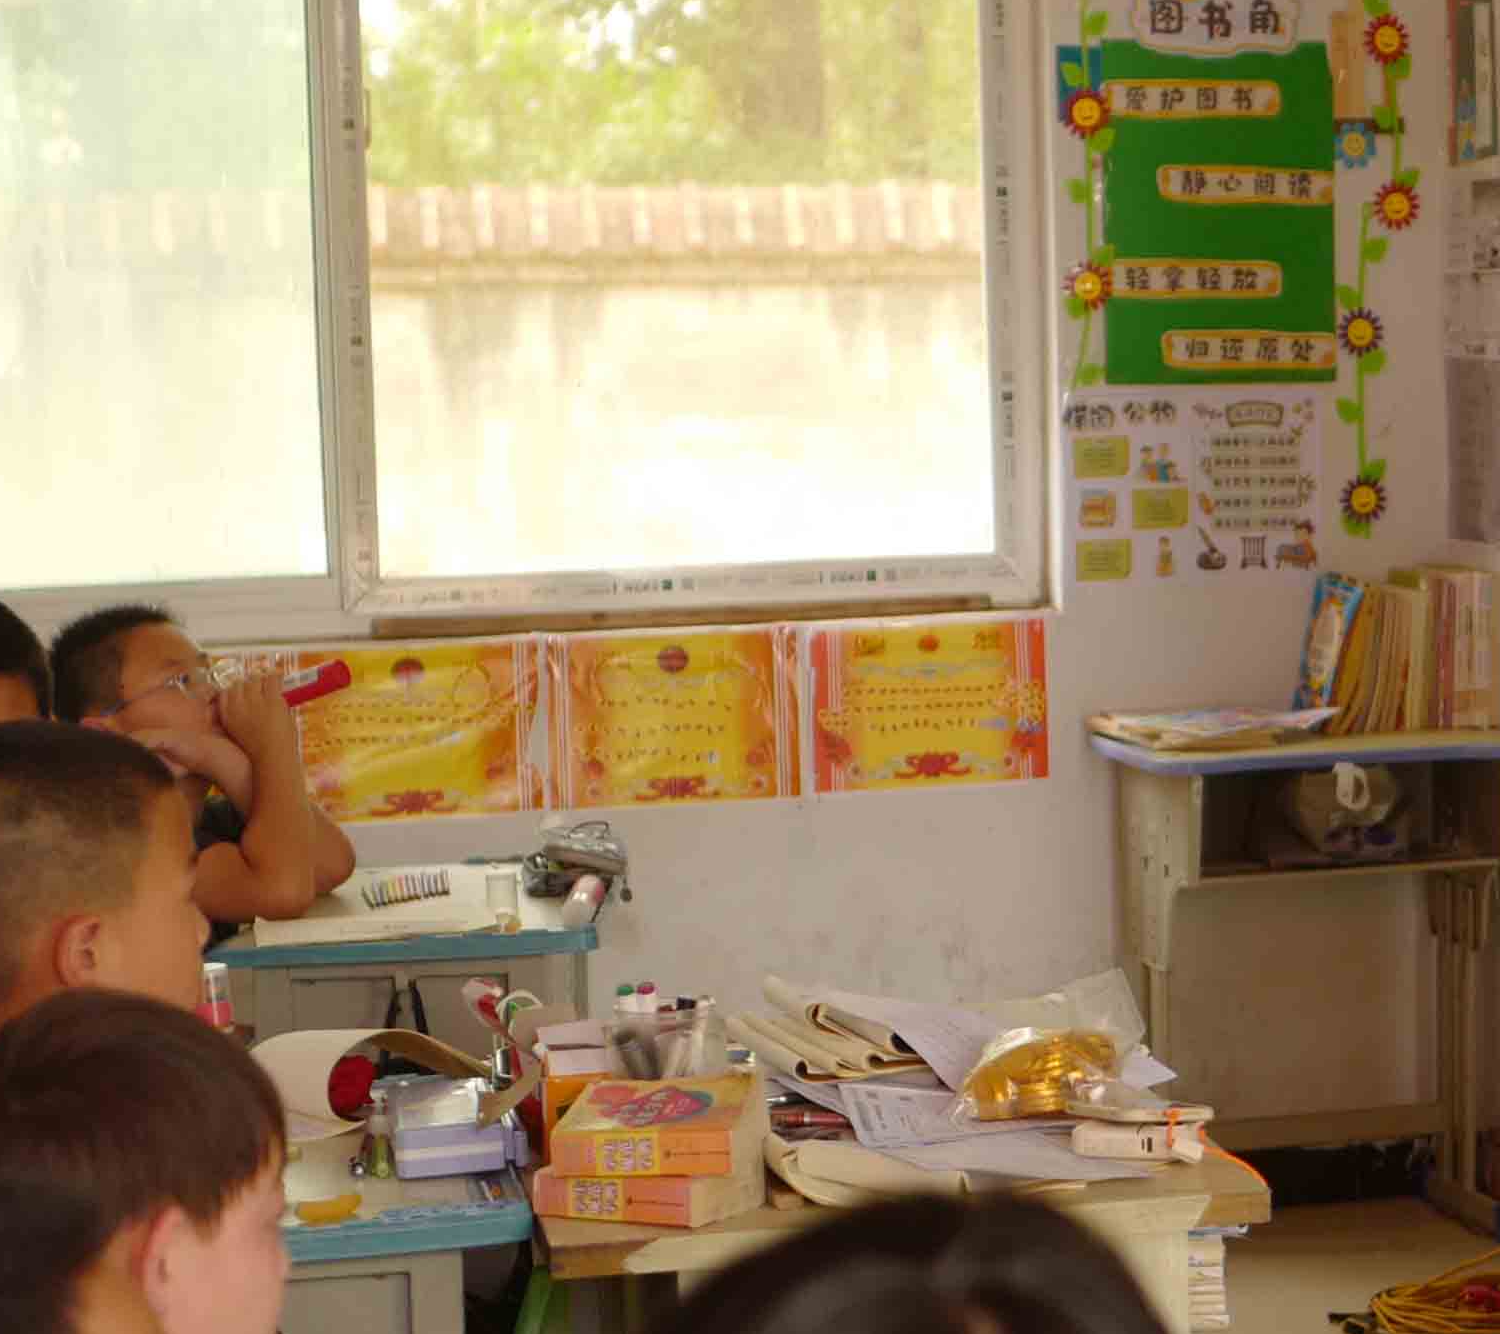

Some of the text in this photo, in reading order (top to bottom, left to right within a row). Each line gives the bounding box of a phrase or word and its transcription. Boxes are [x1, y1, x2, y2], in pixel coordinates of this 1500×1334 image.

[1124, 85, 1255, 112] 爱护图书
[1181, 171, 1313, 199] 静心阅读
[1124, 267, 1259, 293] 轻拿轻放
[1184, 336, 1317, 363] 归还原处
